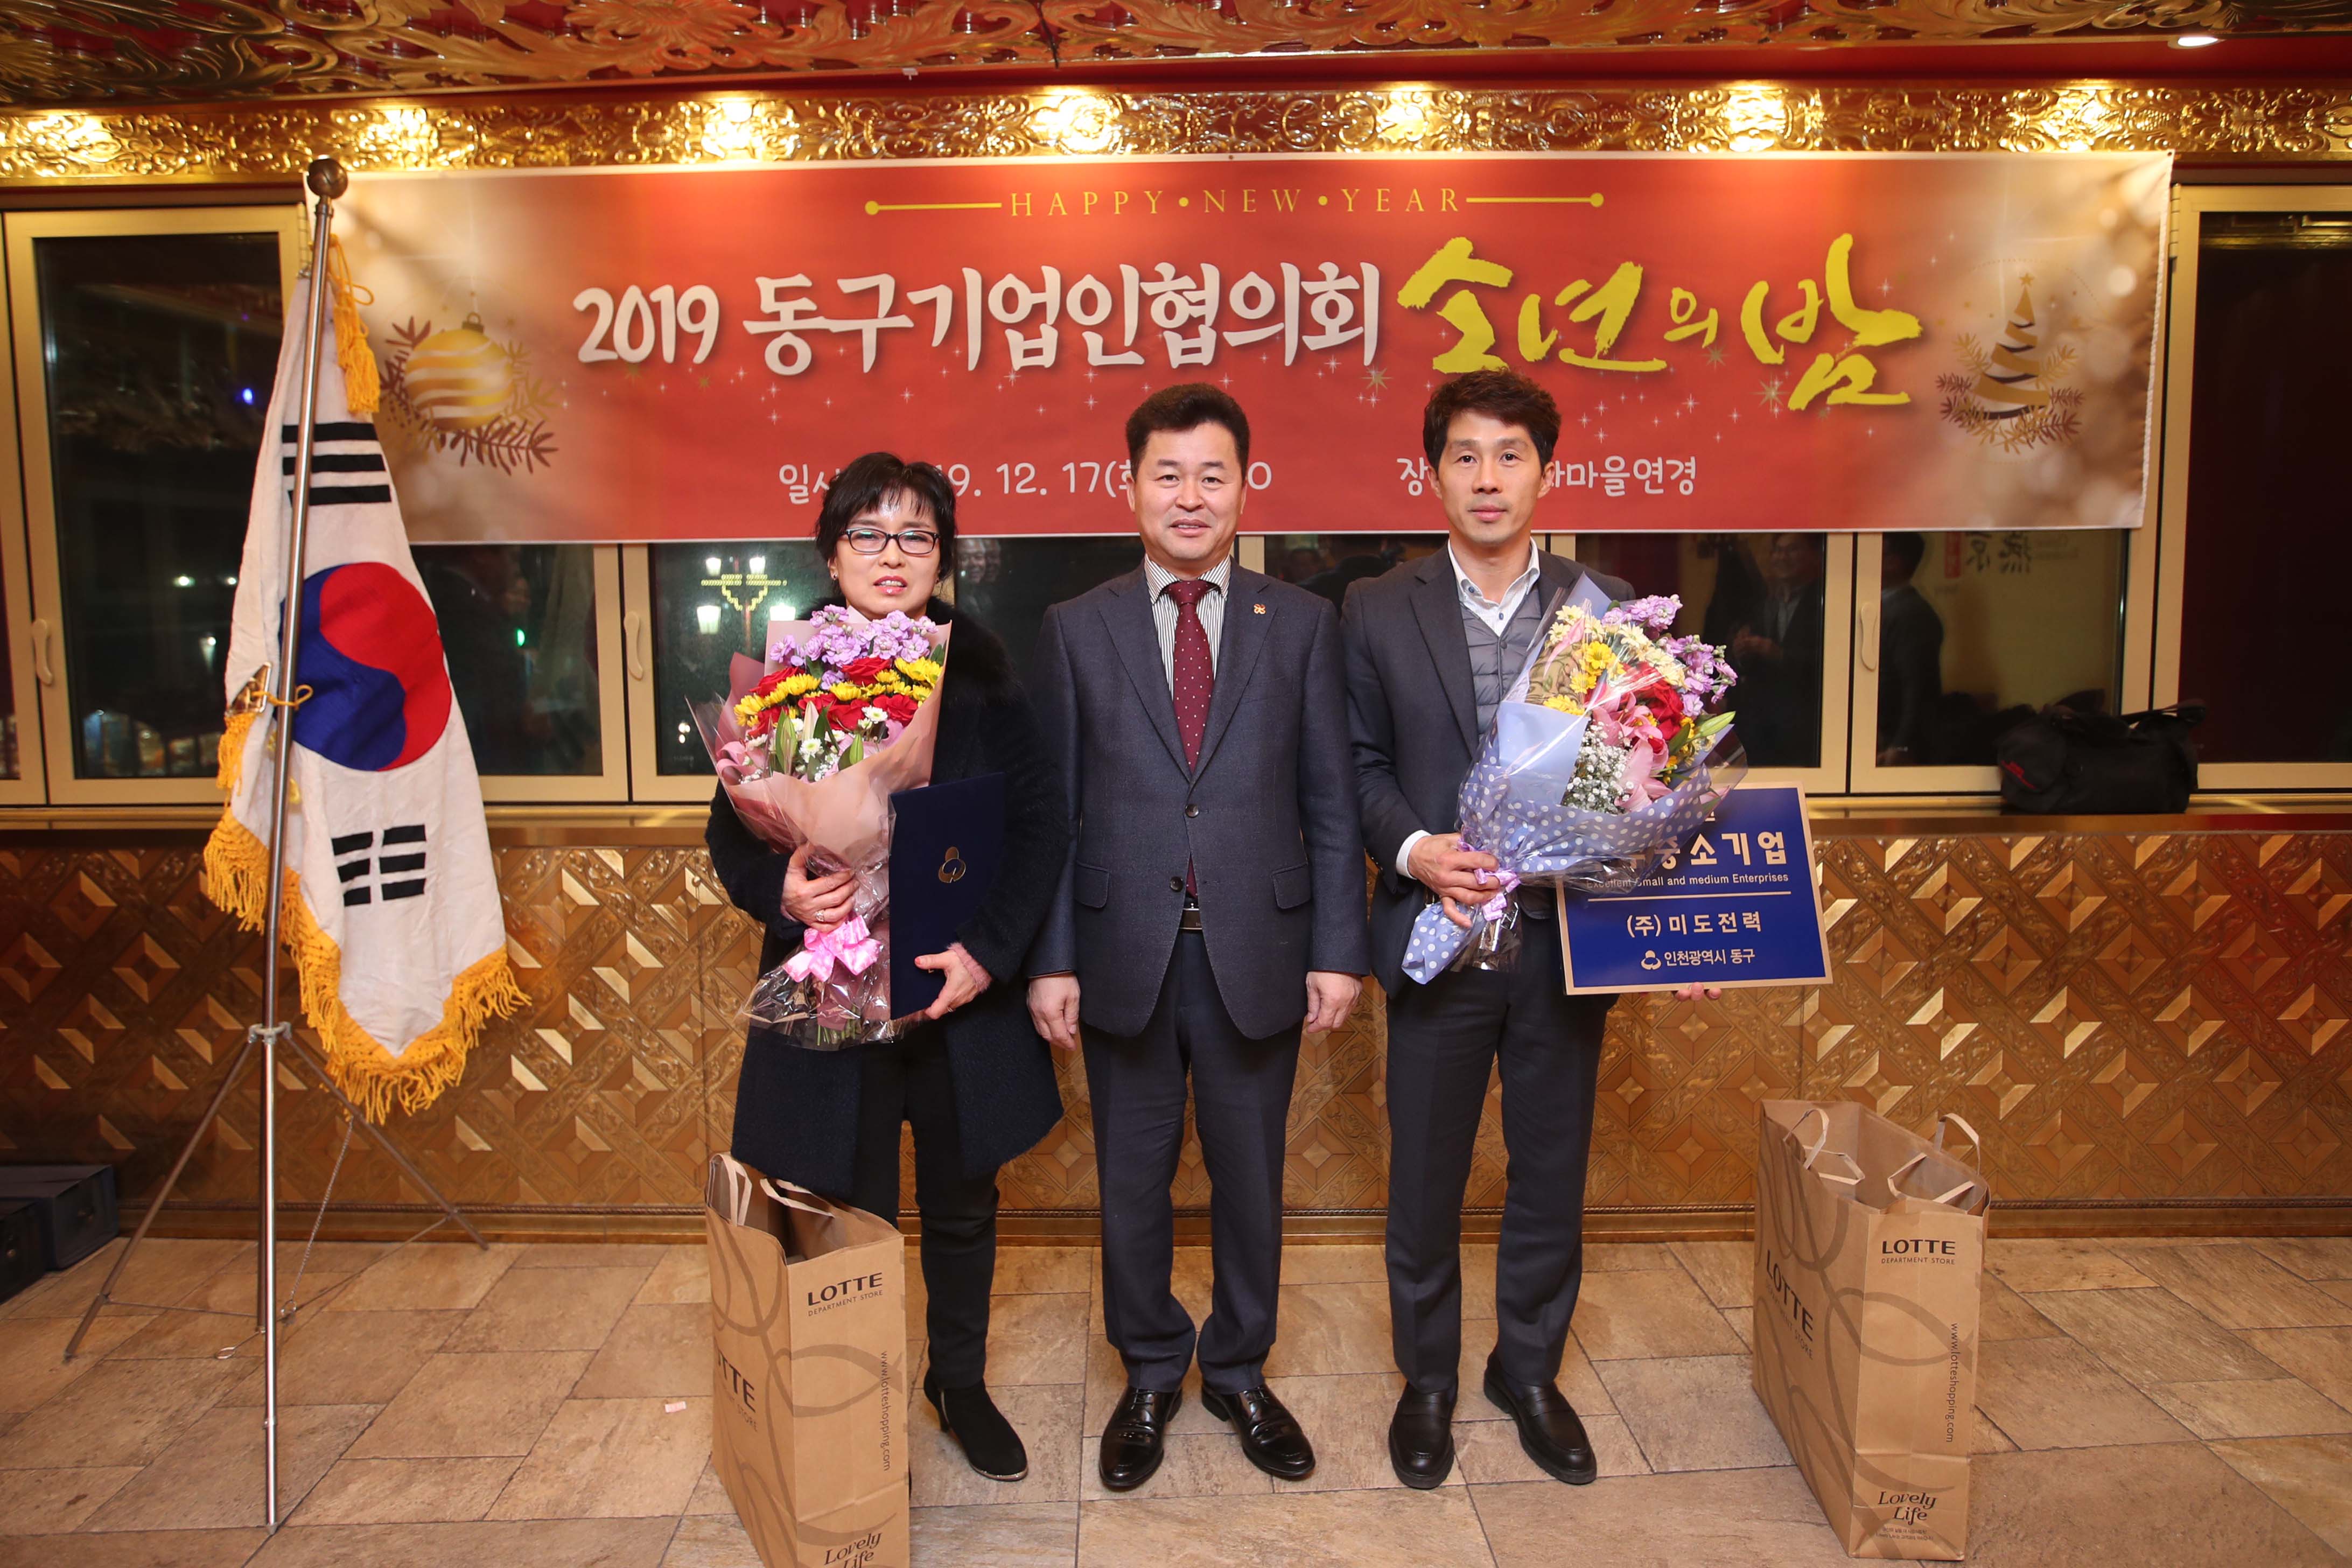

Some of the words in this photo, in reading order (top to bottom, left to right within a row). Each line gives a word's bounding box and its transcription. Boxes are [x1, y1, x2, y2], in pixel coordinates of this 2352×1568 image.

[1010, 191, 1164, 216] HAPPY
[1203, 188, 1301, 213] NEW
[1341, 188, 1459, 212] YEAR
[572, 284, 720, 365] 2019
[743, 261, 1380, 376] 동구기업인협의회
[1740, 233, 1924, 411] 밤
[996, 463, 1048, 496] 12.
[1667, 875, 1686, 886] and
[1689, 874, 1729, 886] medium
[1732, 872, 1789, 884] Enterprises
[1664, 949, 1726, 967] 인천광역시
[1730, 948, 1755, 964] 동구
[1882, 1239, 1956, 1255] LOTTE
[808, 1272, 883, 1306] LOTTE
[808, 1296, 857, 1317] DEPARTMENT
[860, 1290, 883, 1300] STORE
[1767, 1249, 1813, 1342] LOTTE
[1945, 1322, 1961, 1443] www.lotteshopping.com
[880, 1350, 892, 1471] www.lotteshopping.com
[1878, 1491, 1937, 1510] Lovely
[1893, 1506, 1928, 1526] Life
[824, 1533, 883, 1565] Lovely
